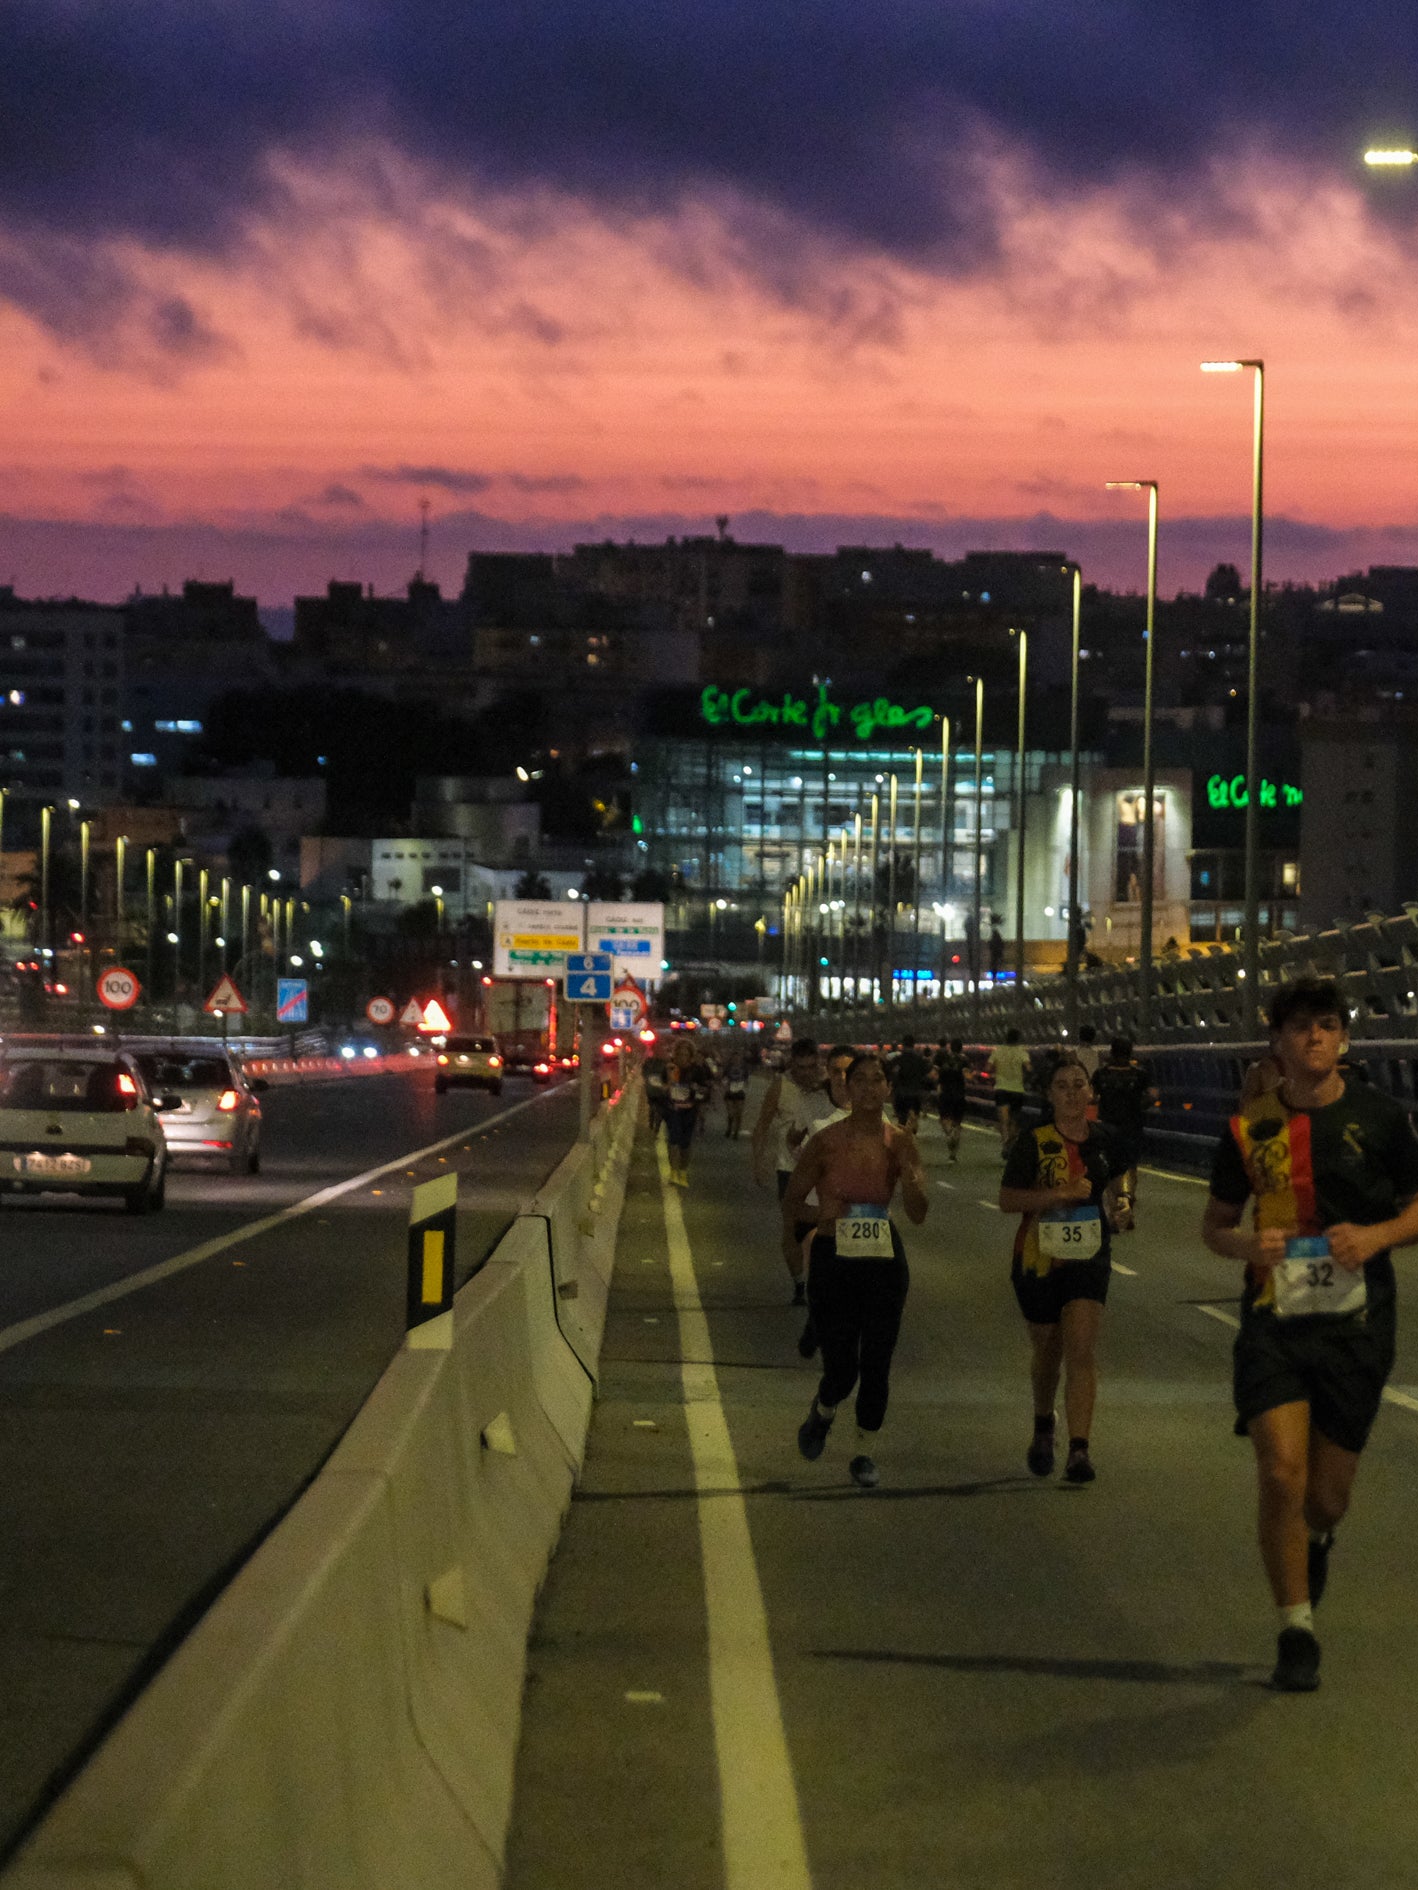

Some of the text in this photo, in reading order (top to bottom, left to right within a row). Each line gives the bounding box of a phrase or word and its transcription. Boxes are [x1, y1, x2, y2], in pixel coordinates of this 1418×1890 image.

[701, 685, 729, 724] El
[731, 687, 809, 725] Corte
[1207, 774, 1230, 810] El
[105, 981, 132, 994] 100
[580, 977, 597, 996] 4
[852, 1222, 879, 1239] 280
[1062, 1226, 1082, 1242] 35
[1306, 1263, 1334, 1287] 32
